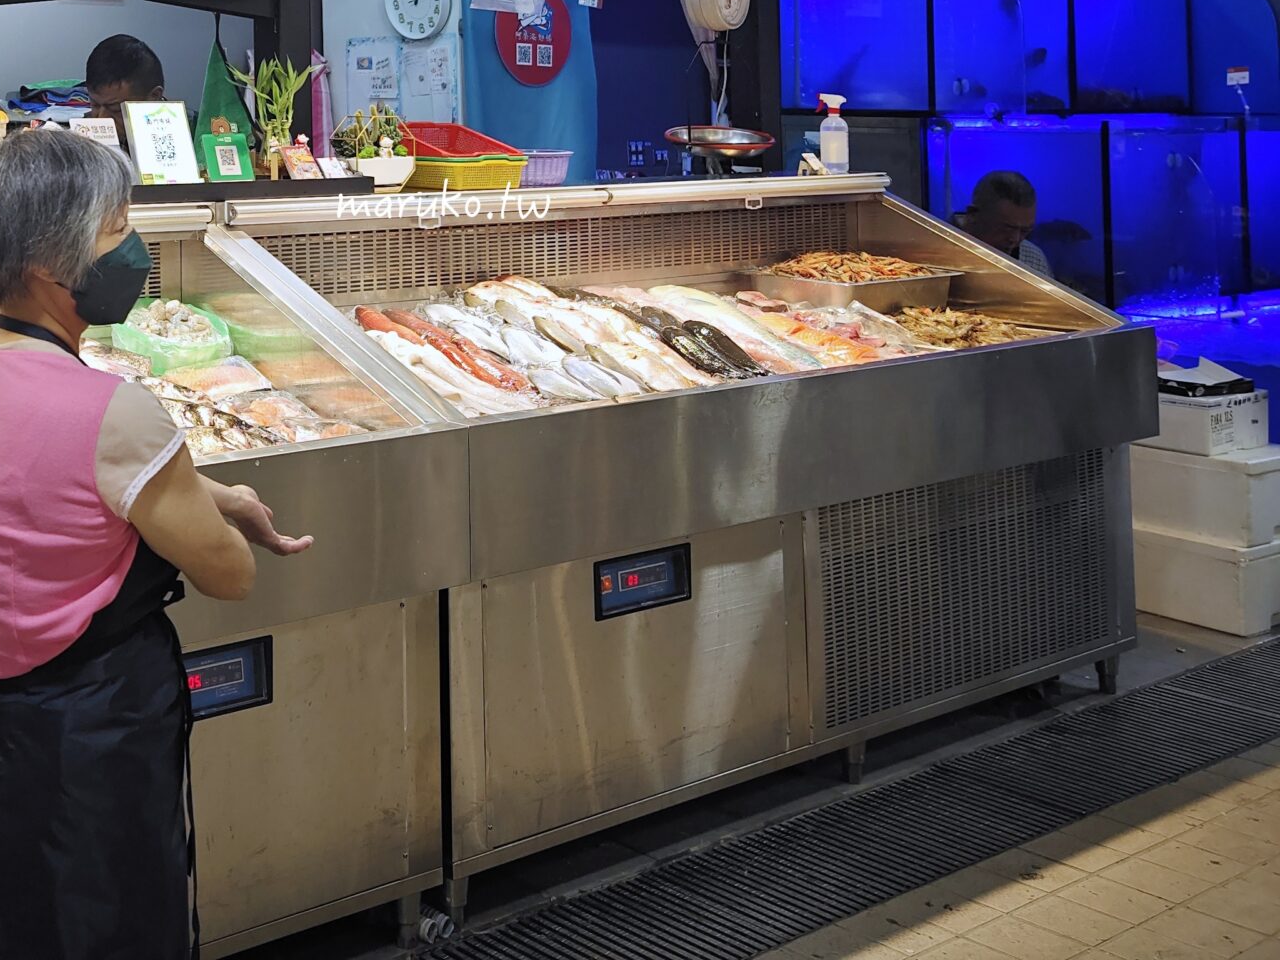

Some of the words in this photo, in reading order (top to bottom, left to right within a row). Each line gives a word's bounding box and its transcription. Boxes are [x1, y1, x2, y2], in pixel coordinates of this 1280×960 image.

[393, 0, 400, 10] 9
[398, 13, 405, 23] 8
[407, 21, 413, 32] 7
[419, 23, 425, 33] 6
